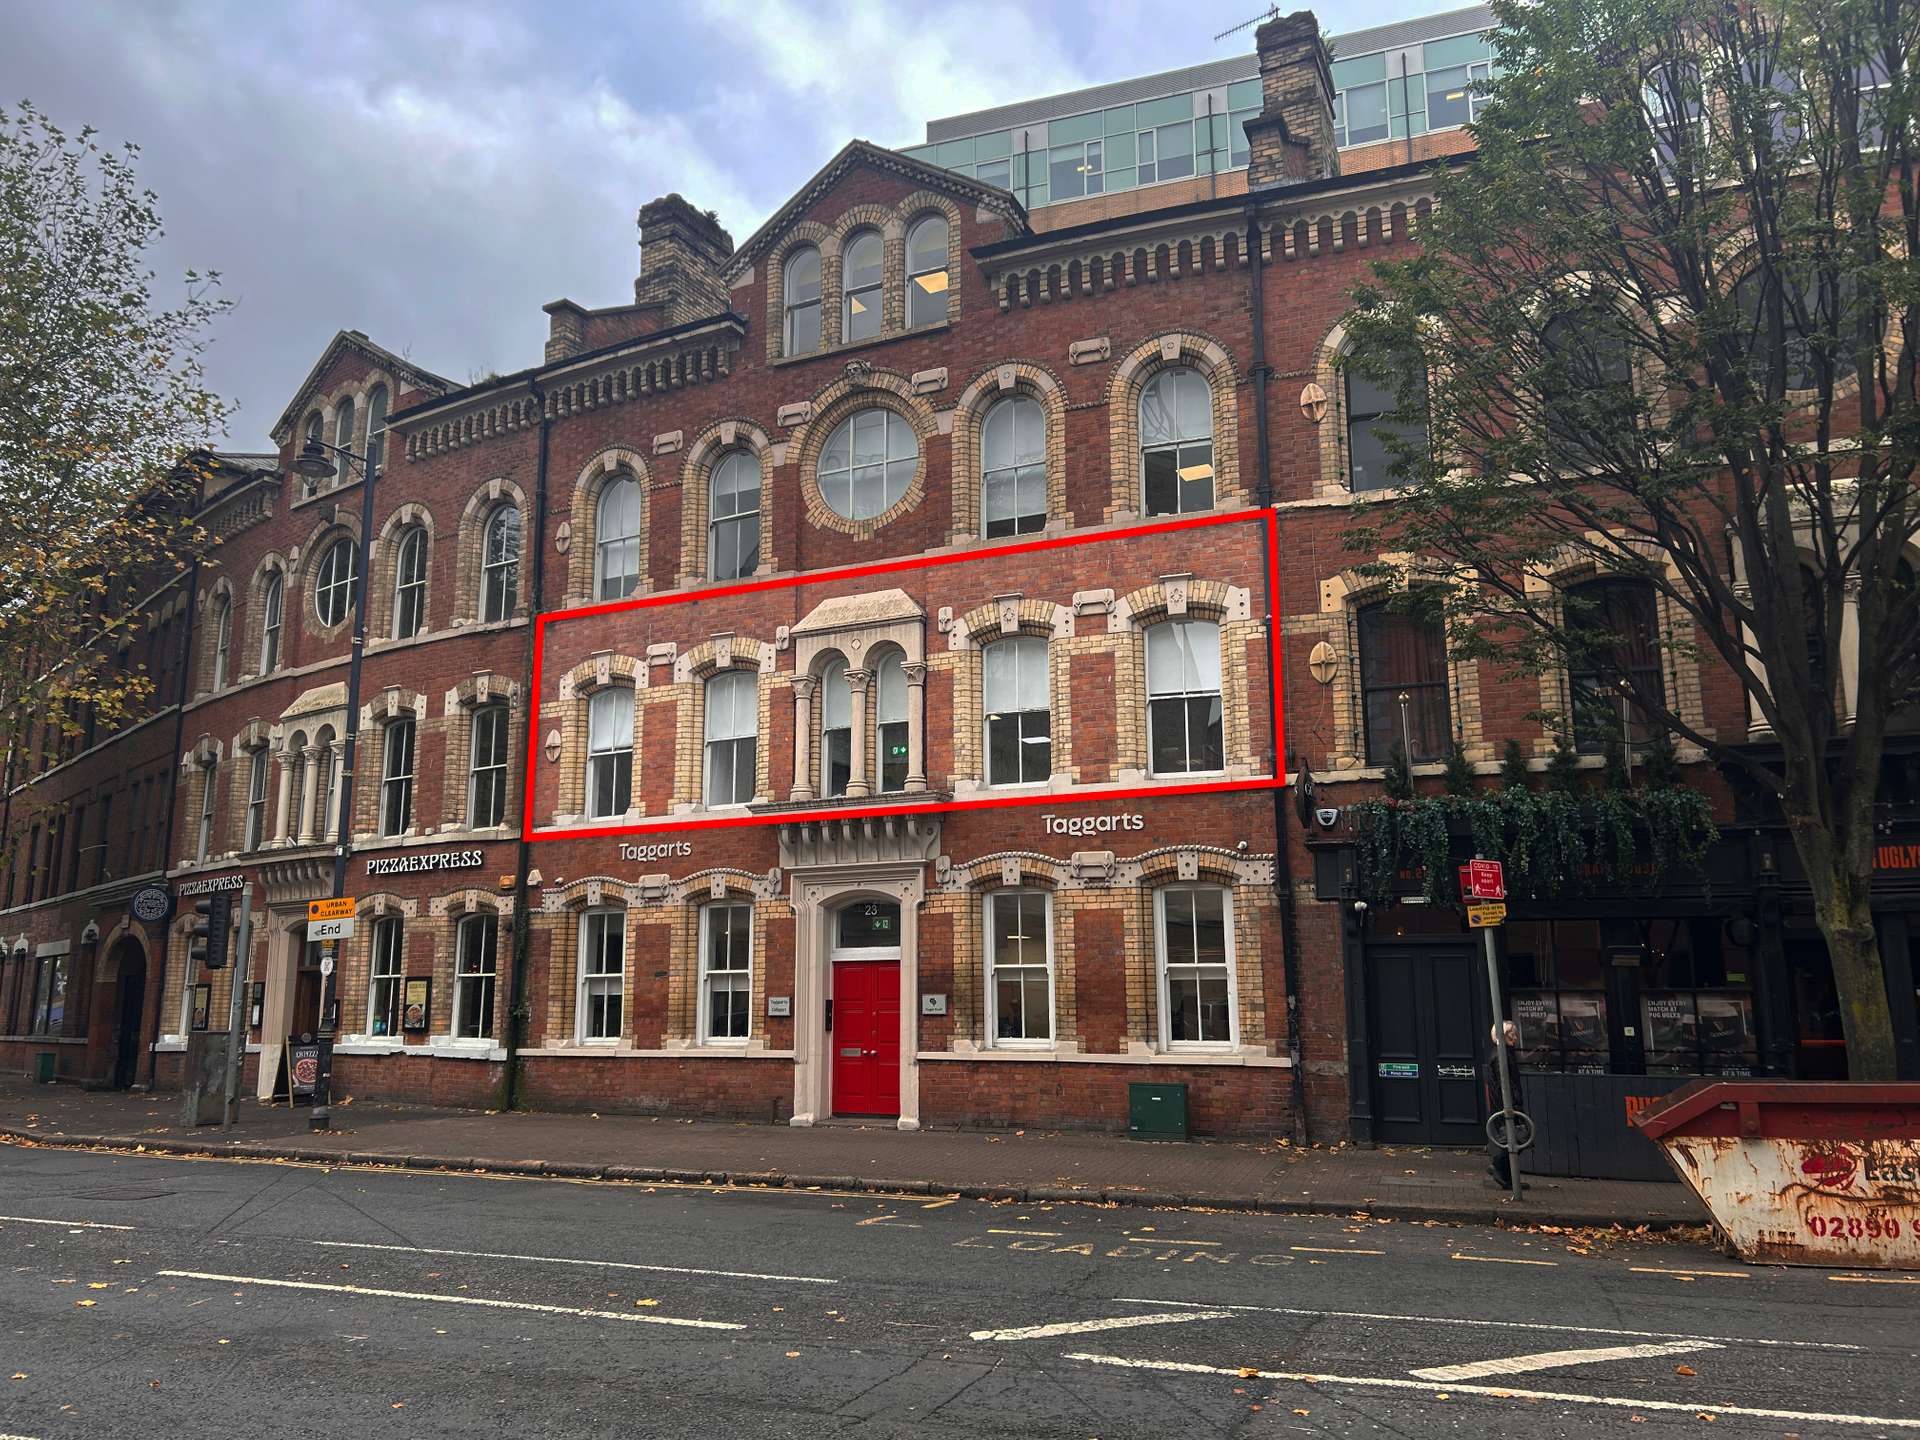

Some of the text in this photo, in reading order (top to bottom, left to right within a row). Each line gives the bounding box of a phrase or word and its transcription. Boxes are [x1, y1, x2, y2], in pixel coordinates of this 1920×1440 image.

[1041, 812, 1144, 836] Taggarts
[619, 841, 692, 862] Taggarts
[366, 850, 482, 875] PIZZAEXPRESS
[179, 875, 244, 896] PIZZAEXPRESS
[321, 909, 353, 917] CLEARWAY
[326, 901, 347, 909] URBAN
[865, 904, 878, 916] 23
[321, 923, 341, 936] End
[1810, 1216, 1900, 1240] 02890
